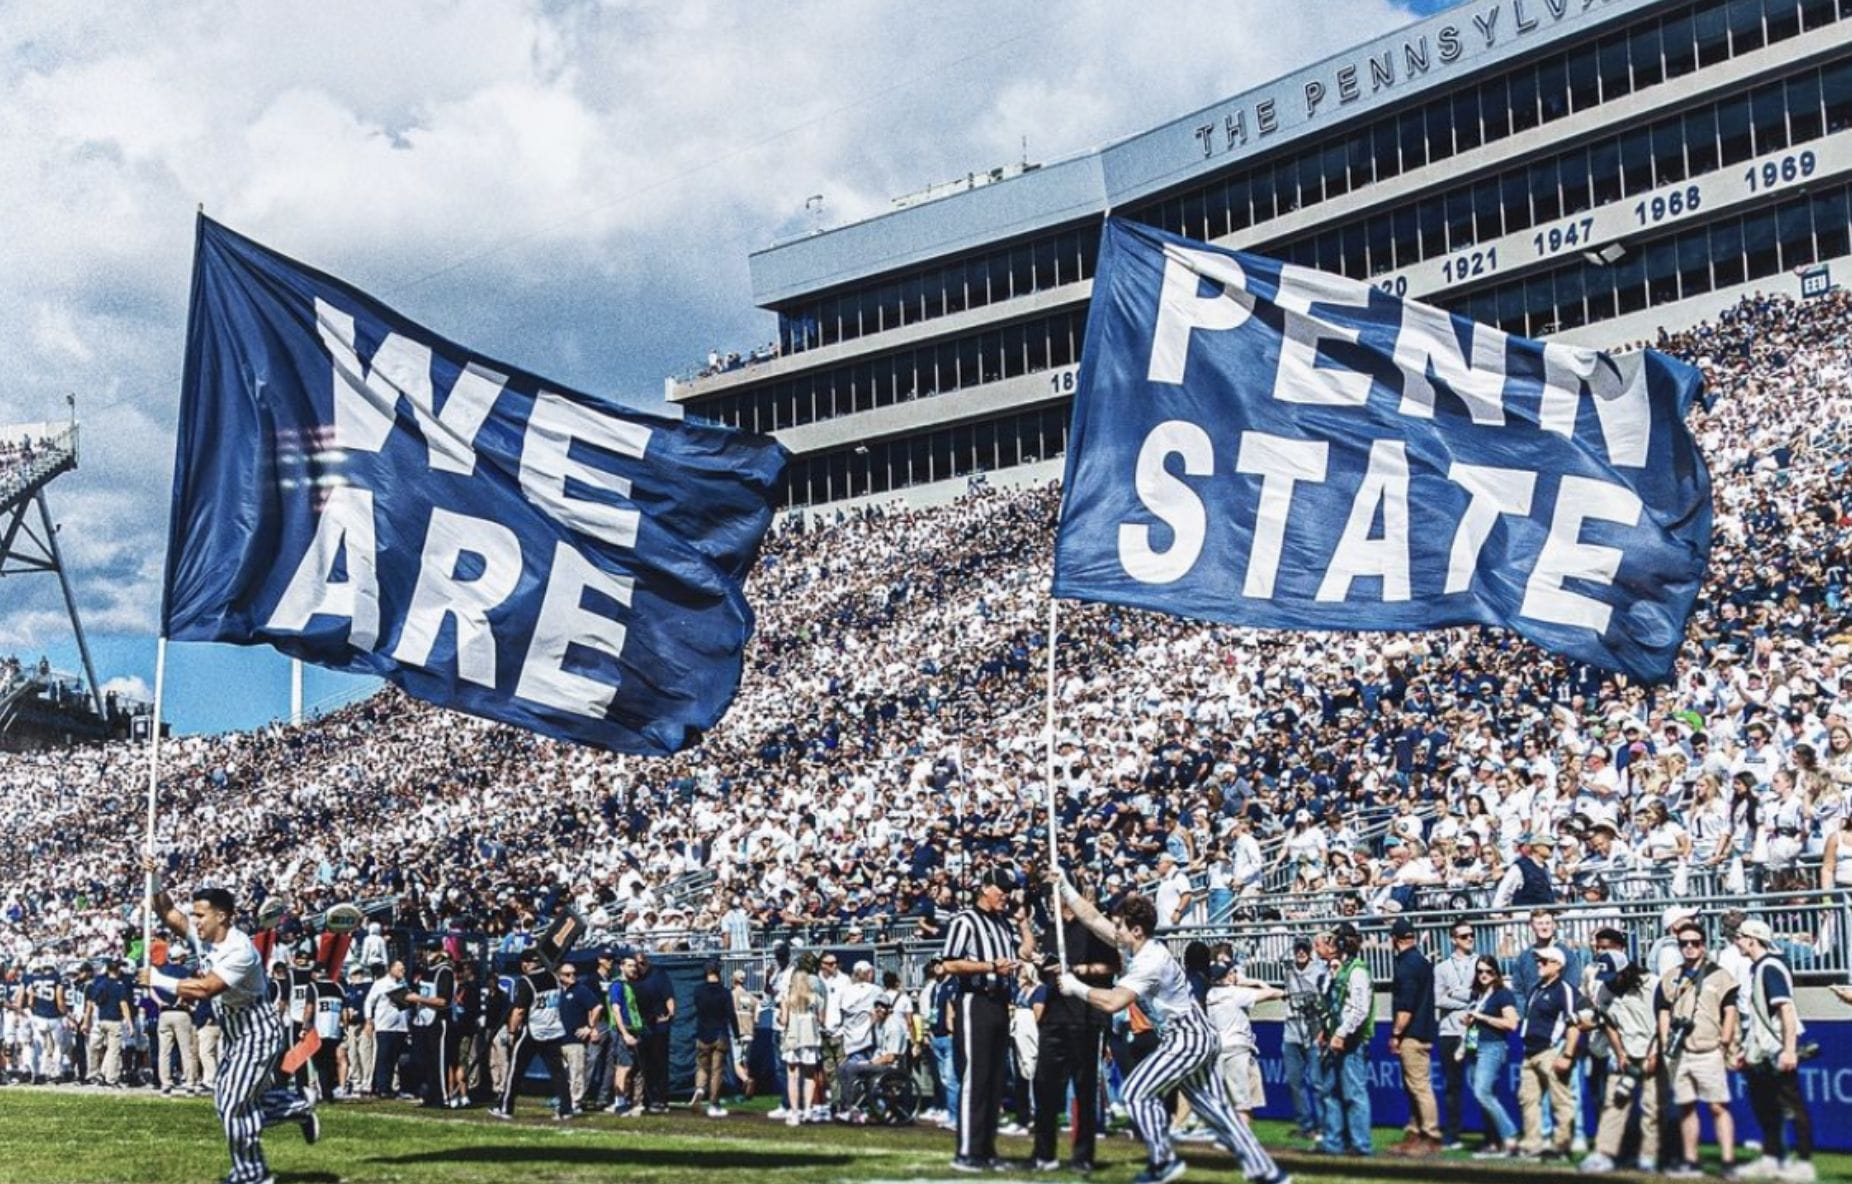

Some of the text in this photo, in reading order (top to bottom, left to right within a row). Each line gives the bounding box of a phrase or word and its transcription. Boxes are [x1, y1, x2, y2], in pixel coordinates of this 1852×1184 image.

[1195, 0, 1612, 158] THE PENNSYLV
[1744, 151, 1817, 193] 1969
[1633, 185, 1701, 226] 1968
[1533, 218, 1595, 256] 1947
[1441, 247, 1498, 284] 1921
[1371, 276, 1407, 298] 20
[1146, 241, 1652, 468] PENN
[1051, 370, 1081, 393] 18
[314, 296, 653, 549] WE
[1117, 420, 1644, 635] STATE
[266, 487, 636, 720] ARE
